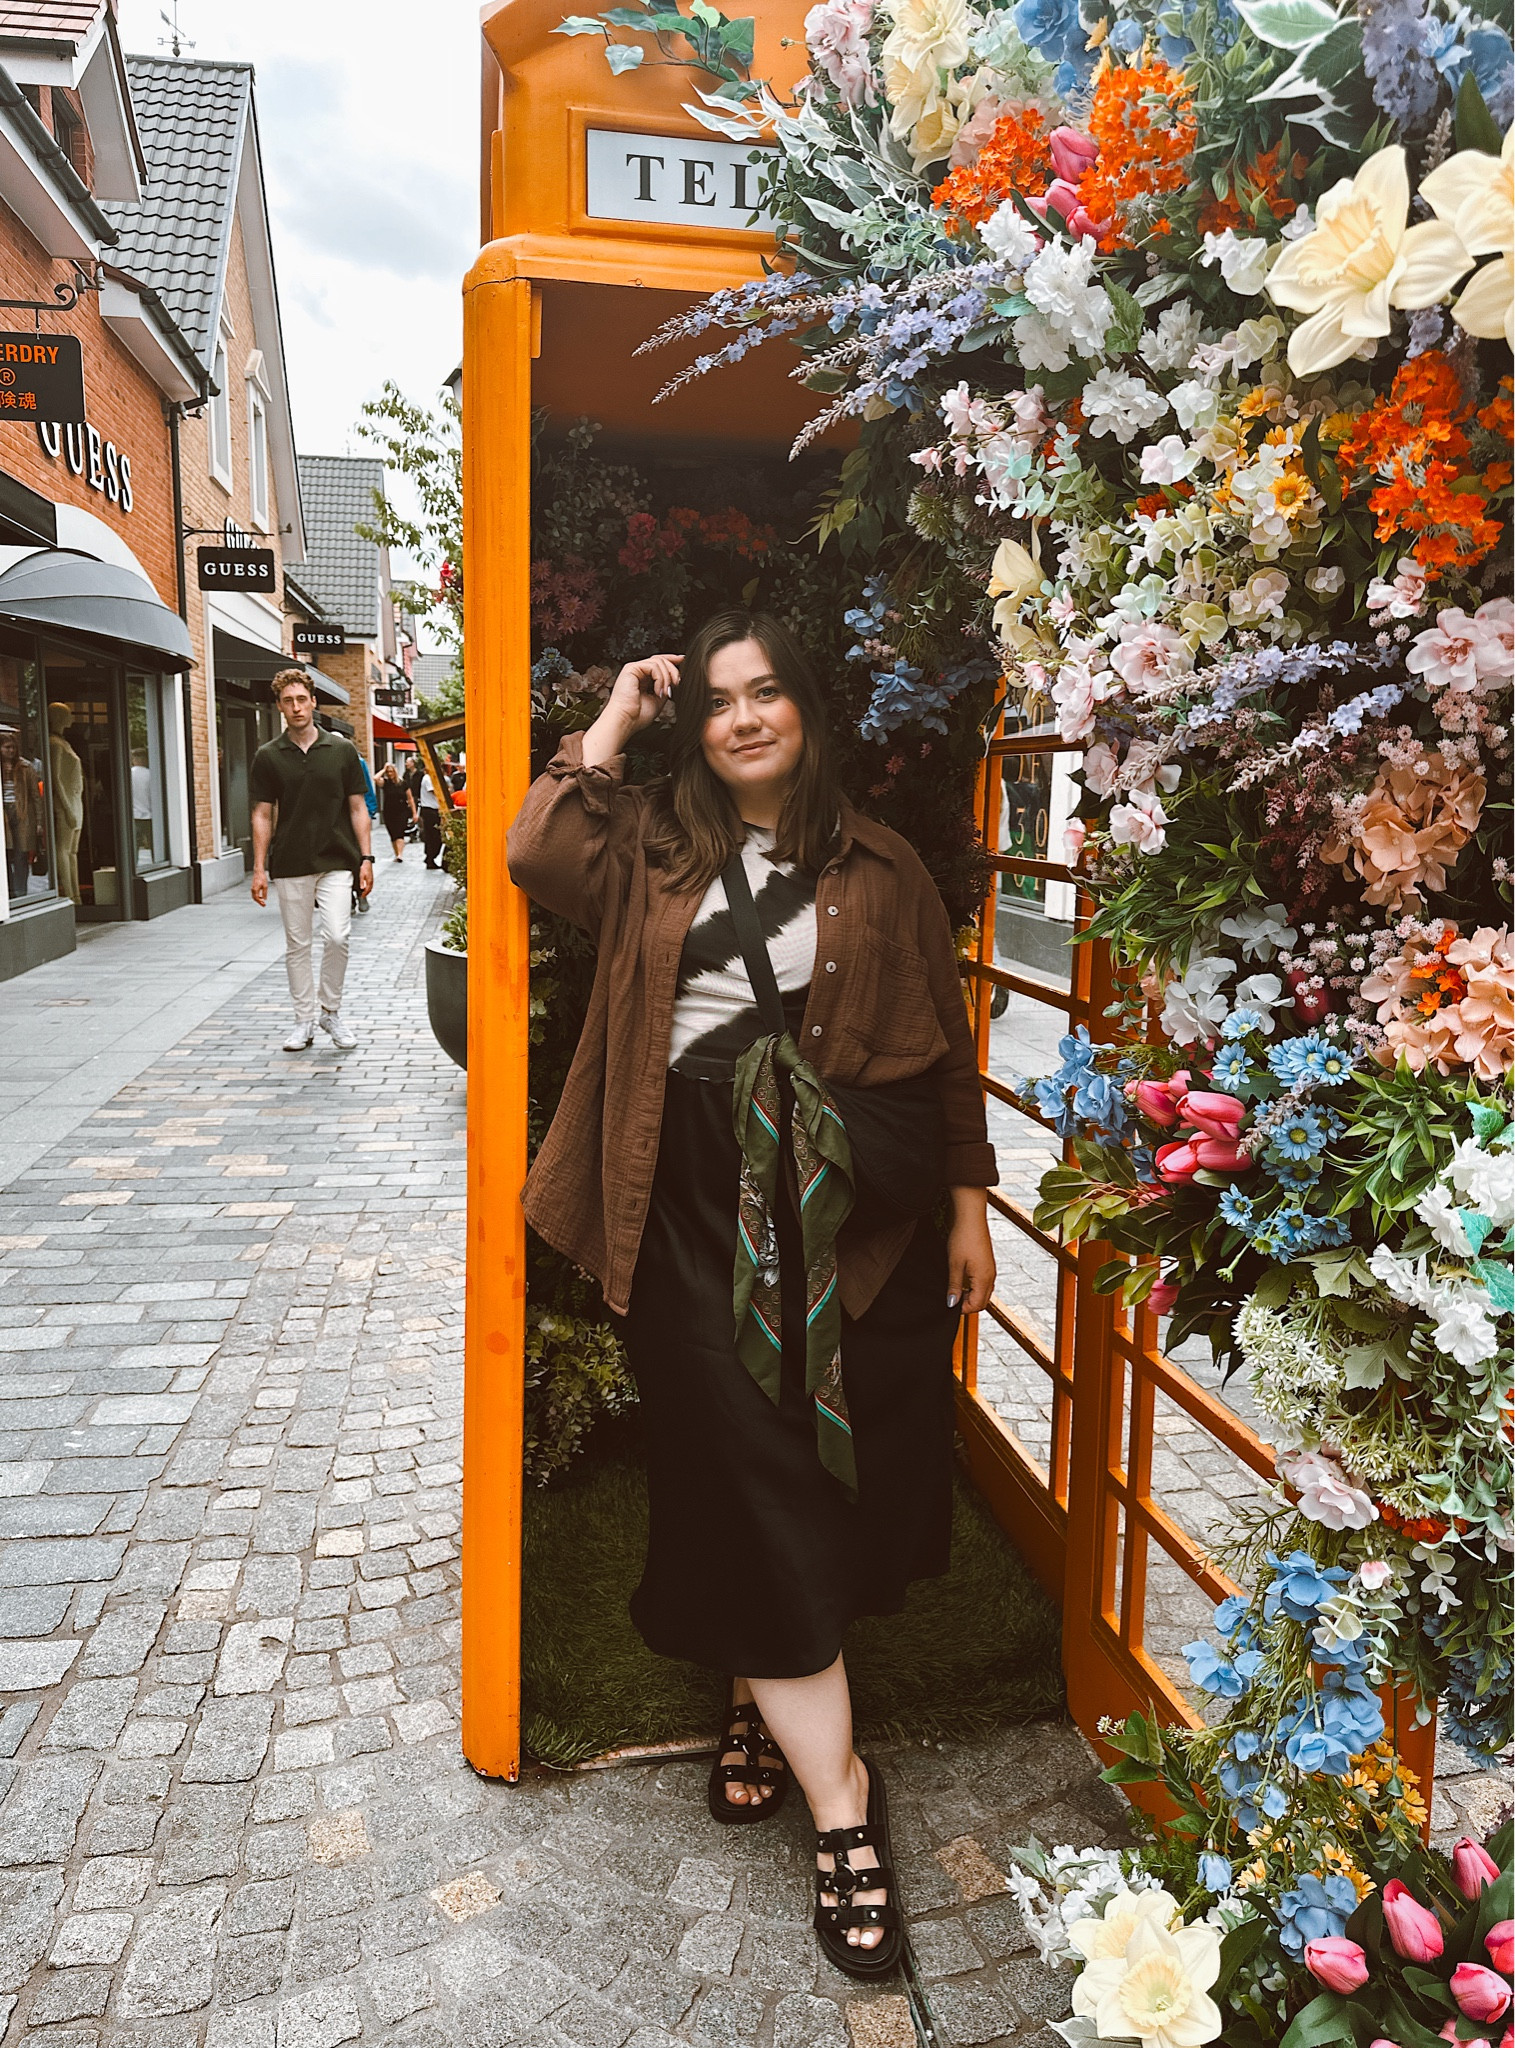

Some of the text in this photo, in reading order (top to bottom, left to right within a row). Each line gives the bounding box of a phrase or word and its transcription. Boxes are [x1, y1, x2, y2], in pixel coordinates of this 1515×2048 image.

[38, 421, 133, 513] GUESS
[204, 562, 269, 577] GUESS
[296, 633, 341, 644] GUESS
[1015, 807, 1048, 848] 30
